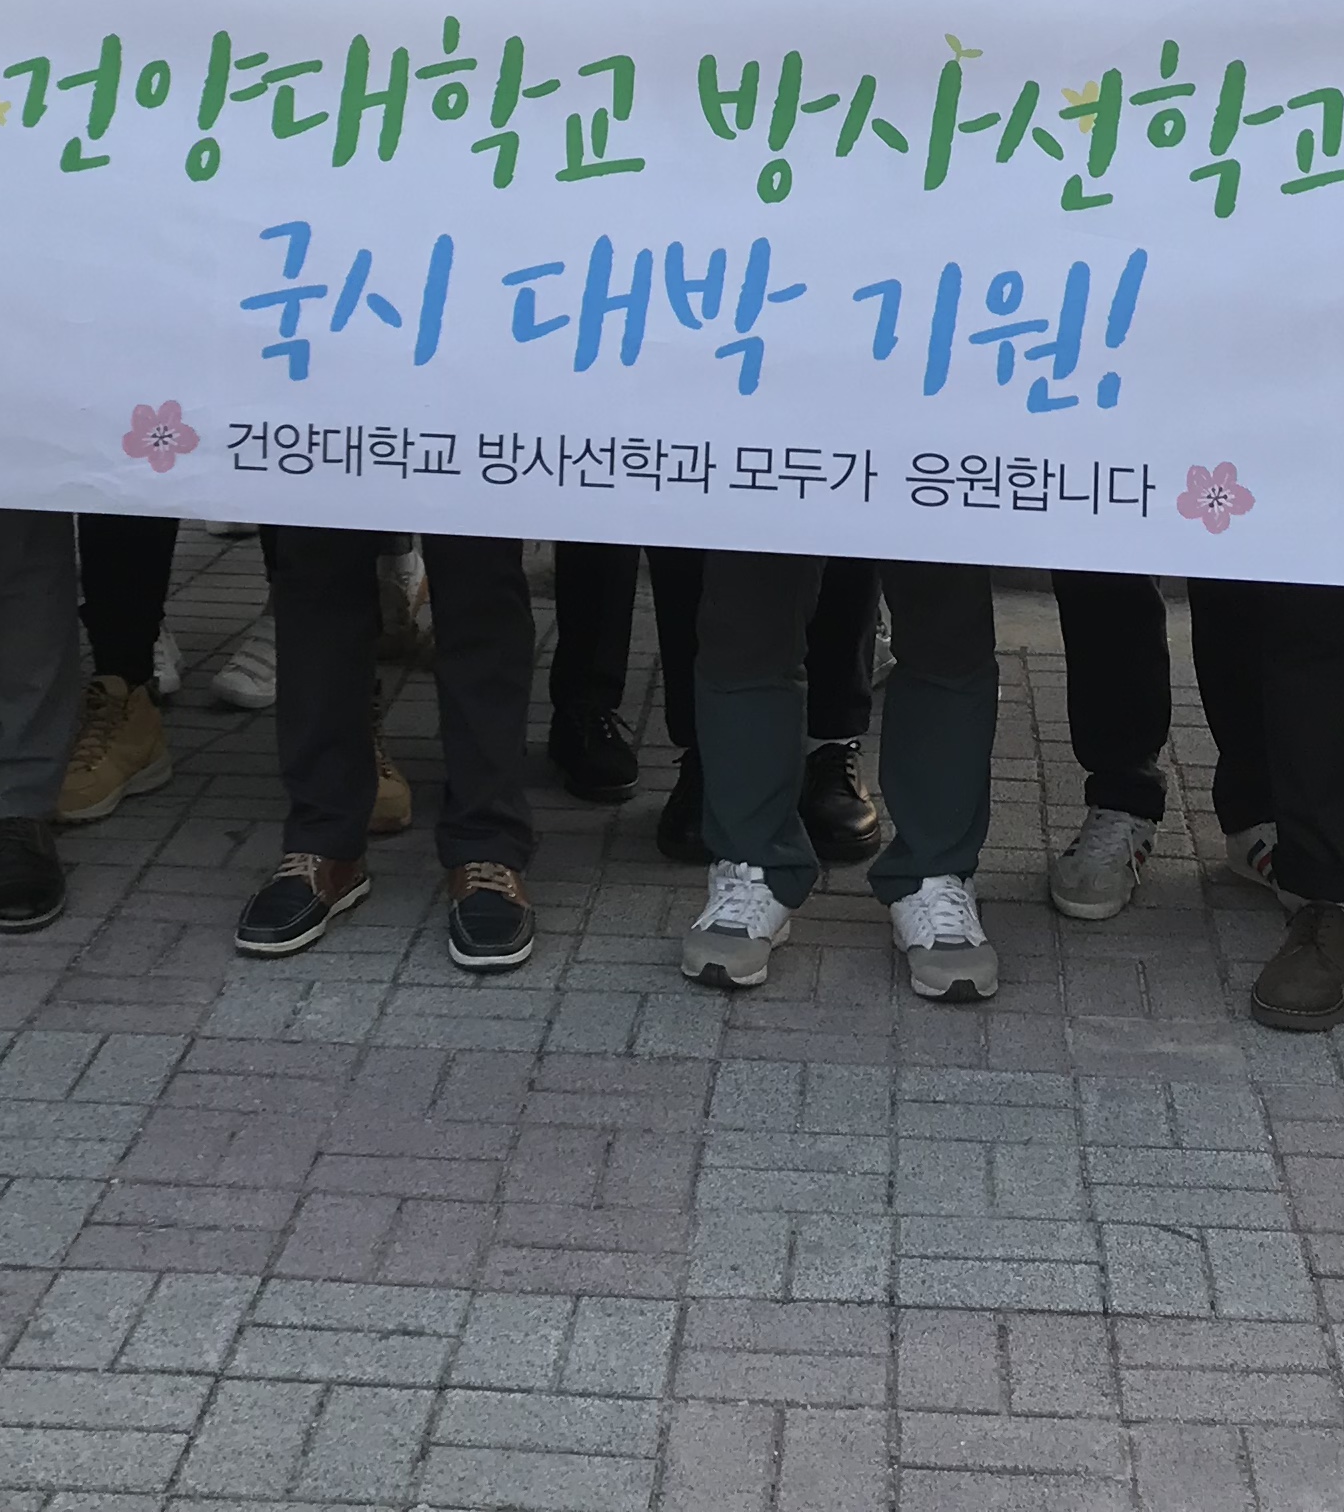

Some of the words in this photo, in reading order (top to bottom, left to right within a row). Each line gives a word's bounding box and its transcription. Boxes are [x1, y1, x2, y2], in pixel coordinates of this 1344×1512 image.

[1, 16, 646, 188] 건양대학교
[240, 220, 456, 381] 국시
[502, 235, 808, 395] 대박
[852, 248, 1149, 412] 기원!
[226, 421, 461, 480] 건양대학교
[477, 431, 718, 495] 방사선학과
[728, 444, 878, 503] 모두가
[905, 452, 1156, 518] 응원합니다
